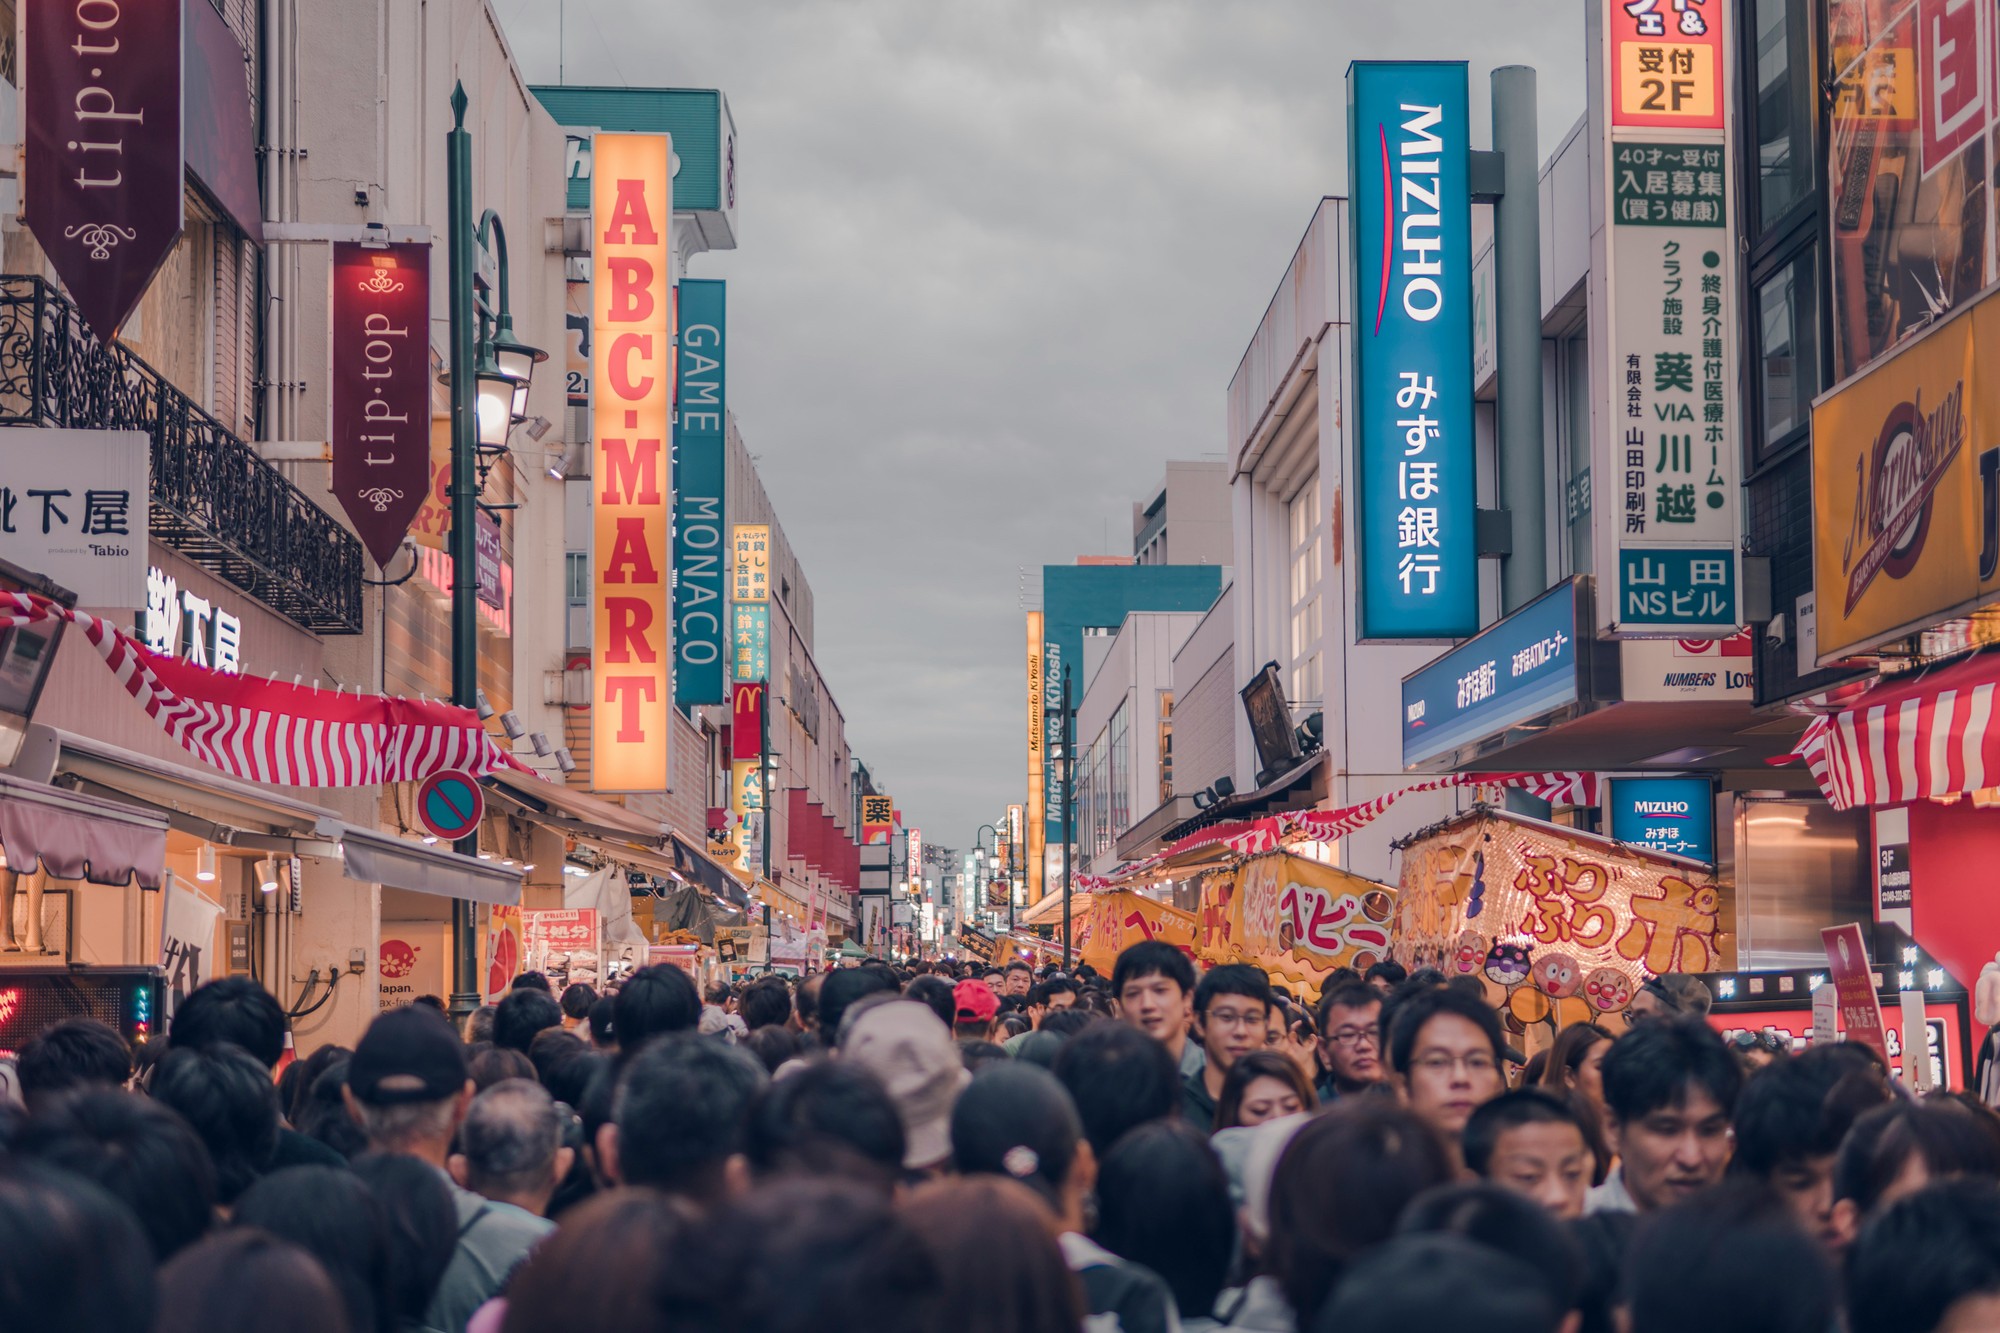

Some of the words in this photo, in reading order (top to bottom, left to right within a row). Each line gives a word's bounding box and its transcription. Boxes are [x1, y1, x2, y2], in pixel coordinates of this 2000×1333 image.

[1638, 47, 1695, 74] 受付
[1640, 78, 1695, 111] 2F
[1618, 170, 1722, 197] 入居募集
[1399, 103, 1443, 322] MIZUHO
[1662, 240, 1683, 335] クラブ施設
[684, 323, 720, 431] GAME
[1626, 354, 1642, 418] 有限会社
[1654, 352, 1694, 393] 葵
[1654, 403, 1695, 422] VIA
[1396, 371, 1442, 596] みずほ銀行
[1625, 426, 1646, 534] 山田印刷所
[1655, 434, 1696, 523] 川越
[88, 544, 129, 556] Tabio
[1628, 556, 1727, 587] 山田
[680, 496, 720, 666] MONACO
[1628, 591, 1727, 619] NSビル
[737, 613, 753, 679] 鈴木薬局
[1046, 643, 1061, 711] KiYoshi
[1457, 659, 1497, 709] みずほ銀行
[1663, 672, 1717, 687] NUMBERS
[1030, 693, 1039, 752] Matsumoto
[866, 798, 890, 823] 薬
[1634, 801, 1689, 813] MIZUHO
[1645, 827, 1680, 840] みずほ
[1881, 849, 1894, 868] 3F
[1280, 886, 1388, 950] ベビー
